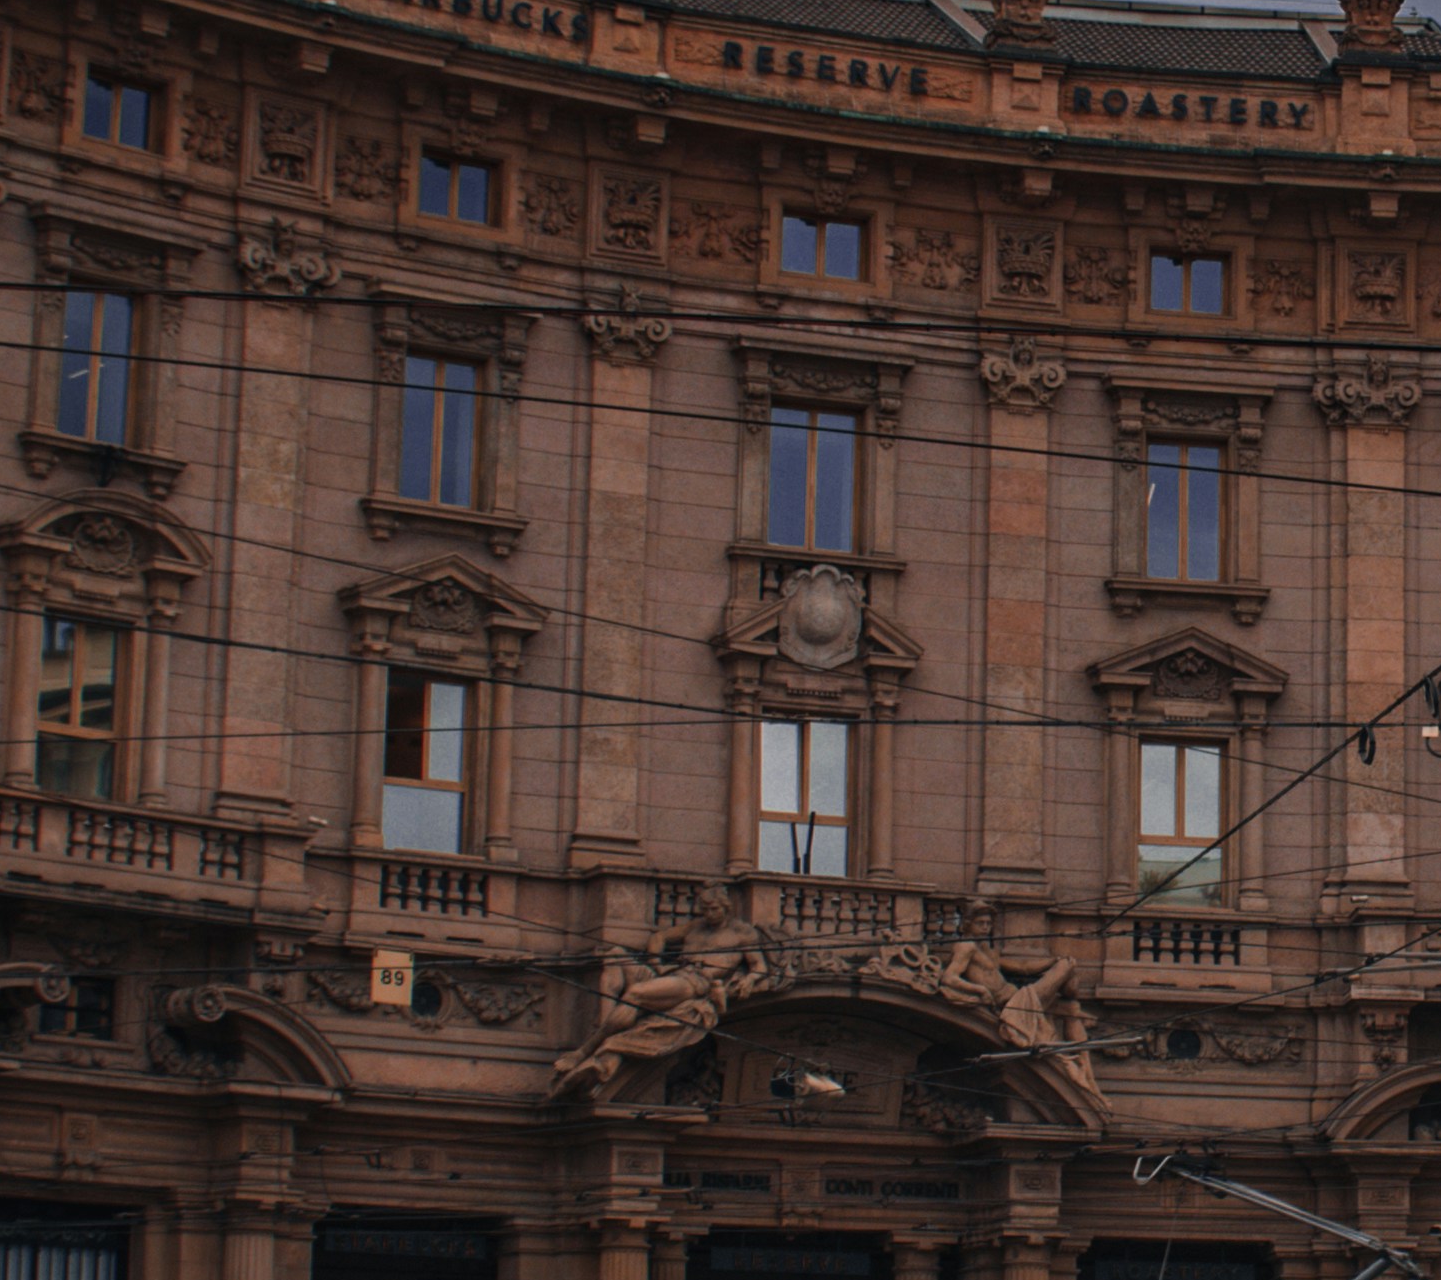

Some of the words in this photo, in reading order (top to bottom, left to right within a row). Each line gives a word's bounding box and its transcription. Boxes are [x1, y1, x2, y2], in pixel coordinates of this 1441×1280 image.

[724, 41, 929, 96] RESERVE
[1073, 86, 1309, 128] ROASTERY
[381, 969, 404, 986] 89
[880, 1181, 959, 1199] CORRENTI
